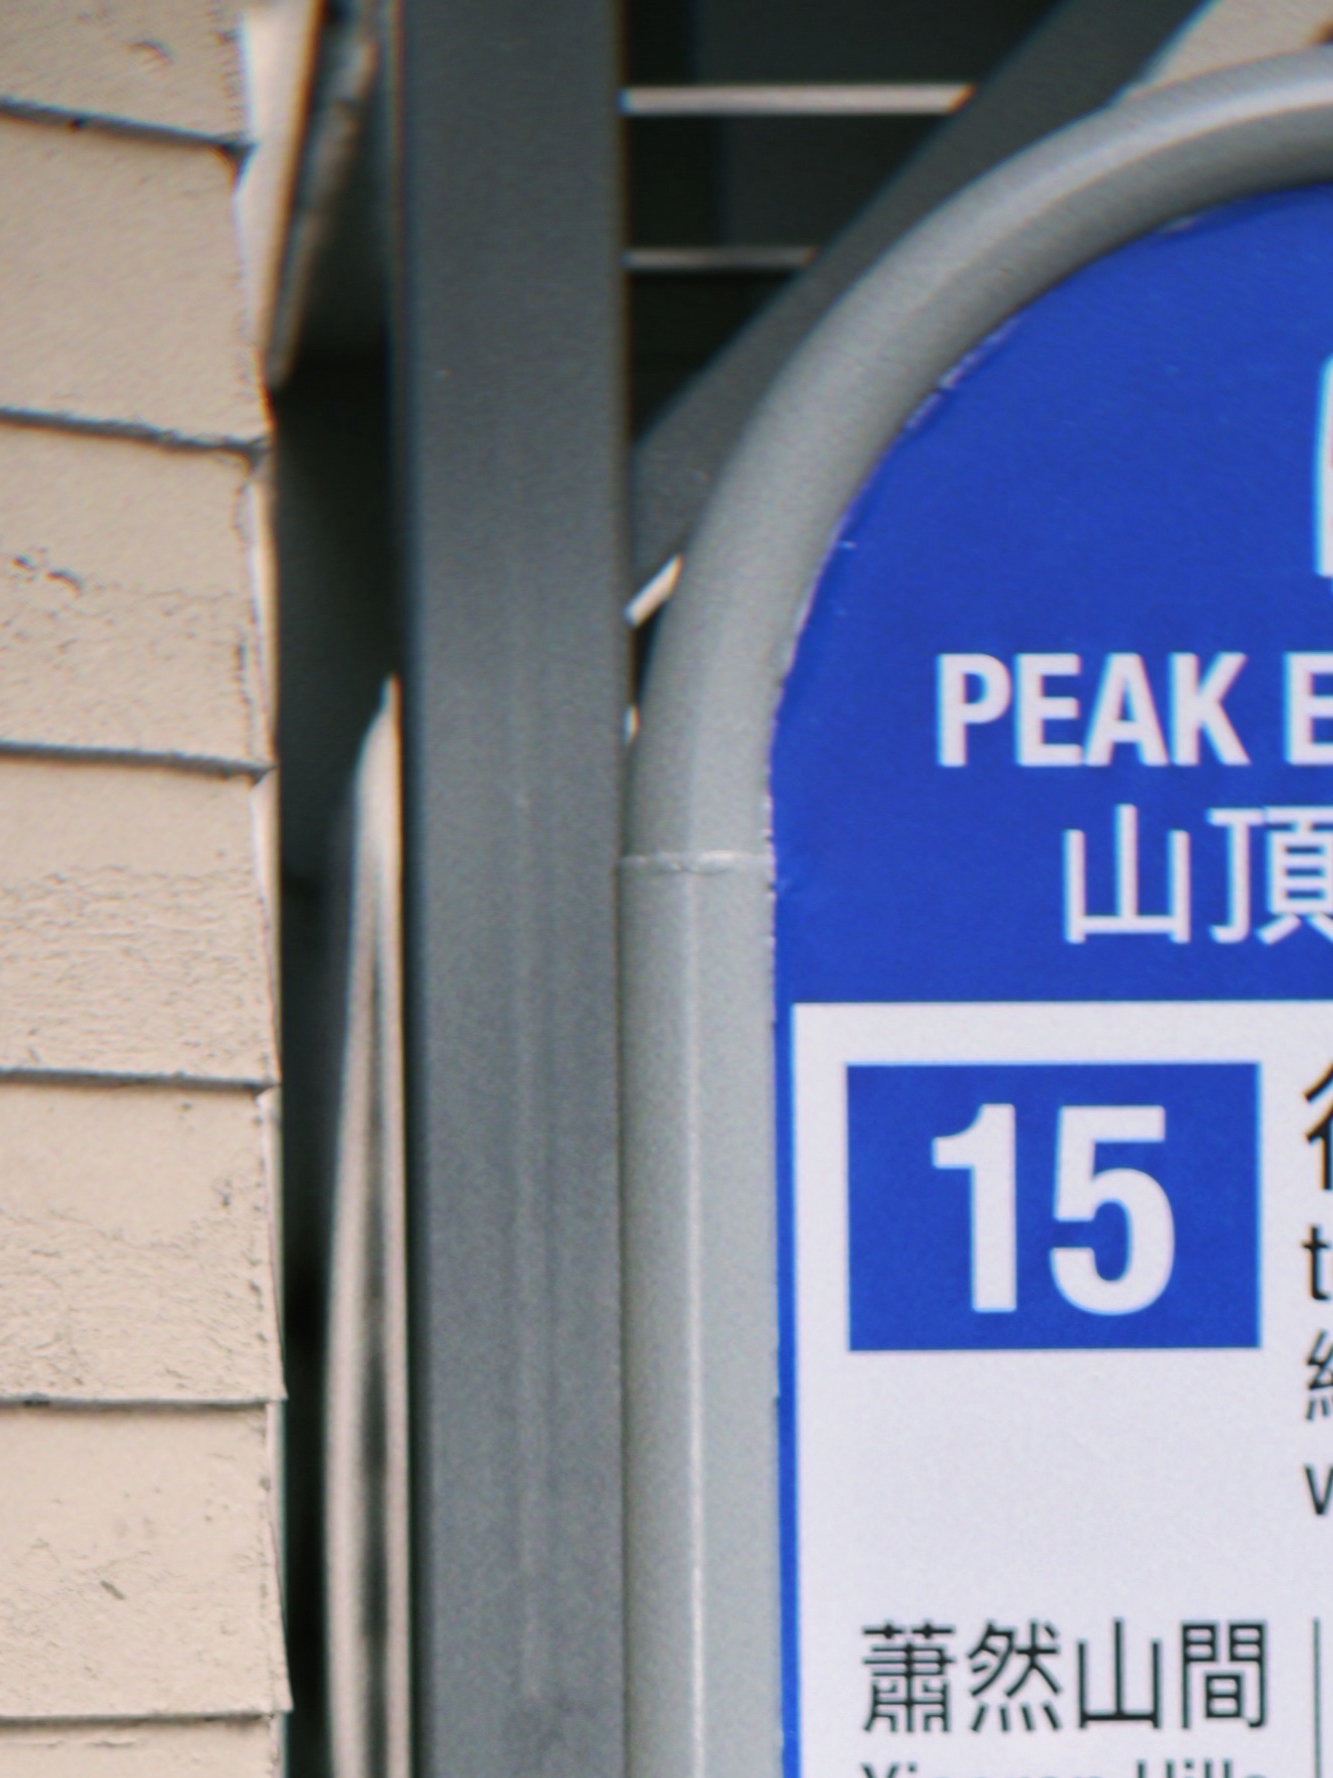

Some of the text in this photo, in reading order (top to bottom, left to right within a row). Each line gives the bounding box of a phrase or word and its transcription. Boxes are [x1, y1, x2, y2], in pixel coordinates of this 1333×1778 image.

[937, 652, 1249, 767] PEAK
[932, 1104, 1174, 1315] 15
[863, 1621, 1266, 1732] 蕭然山間
